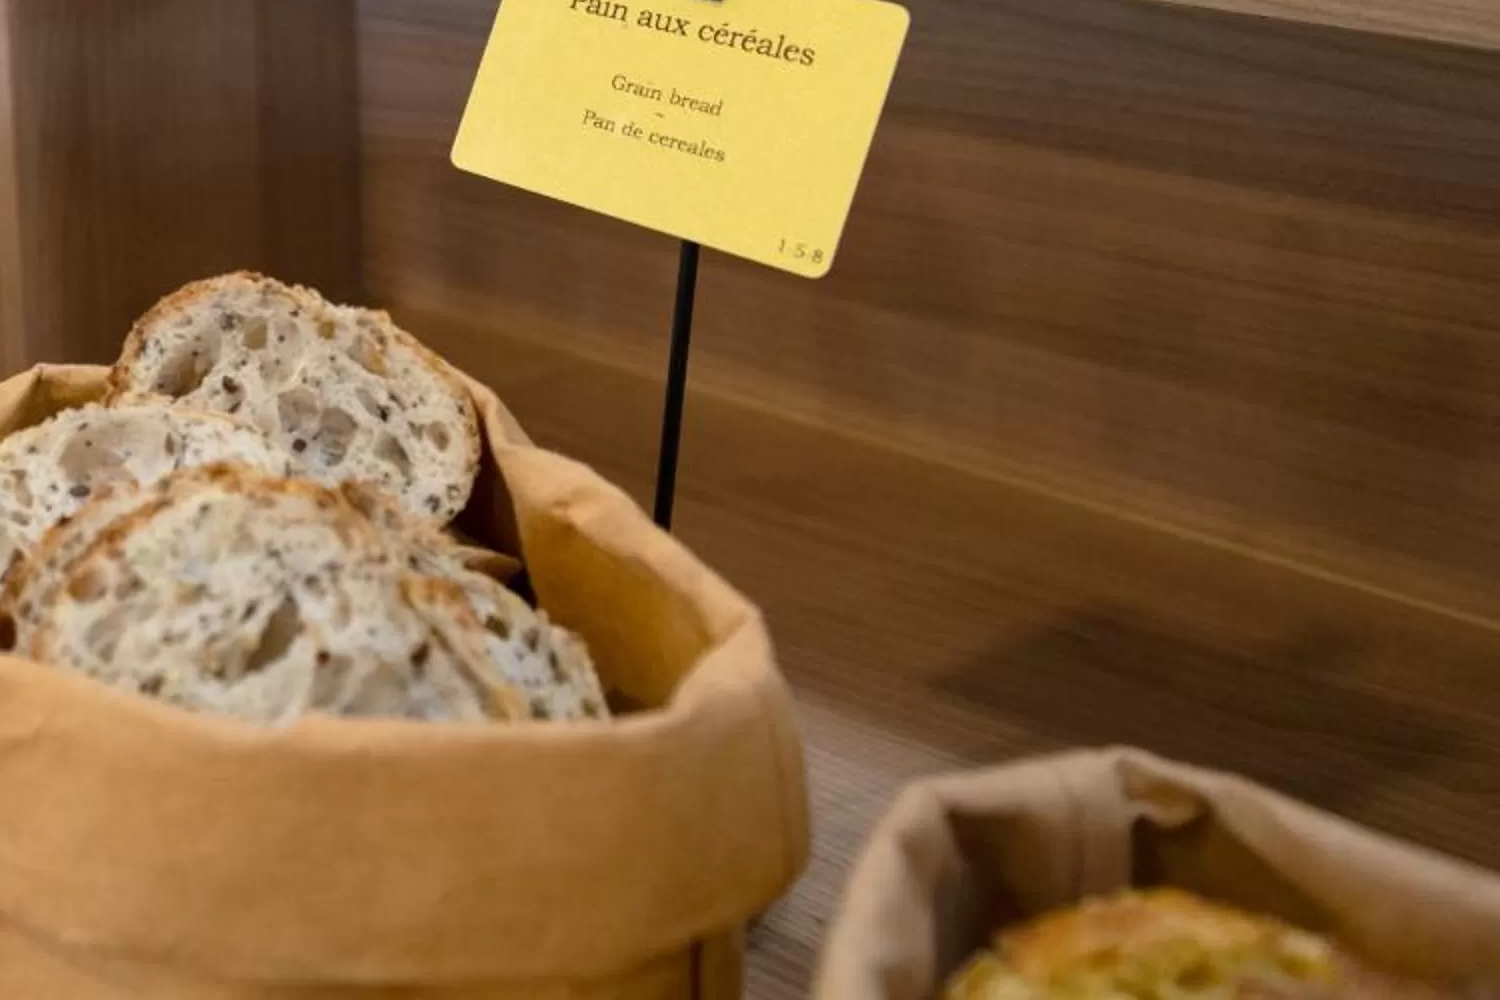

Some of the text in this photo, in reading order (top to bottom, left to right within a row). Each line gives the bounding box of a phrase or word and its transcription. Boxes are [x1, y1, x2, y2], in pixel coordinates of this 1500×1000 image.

[637, 8, 691, 37] aux
[698, 22, 816, 67] céréales
[611, 73, 725, 117] Grain bread
[582, 108, 726, 163] Pan de cereales
